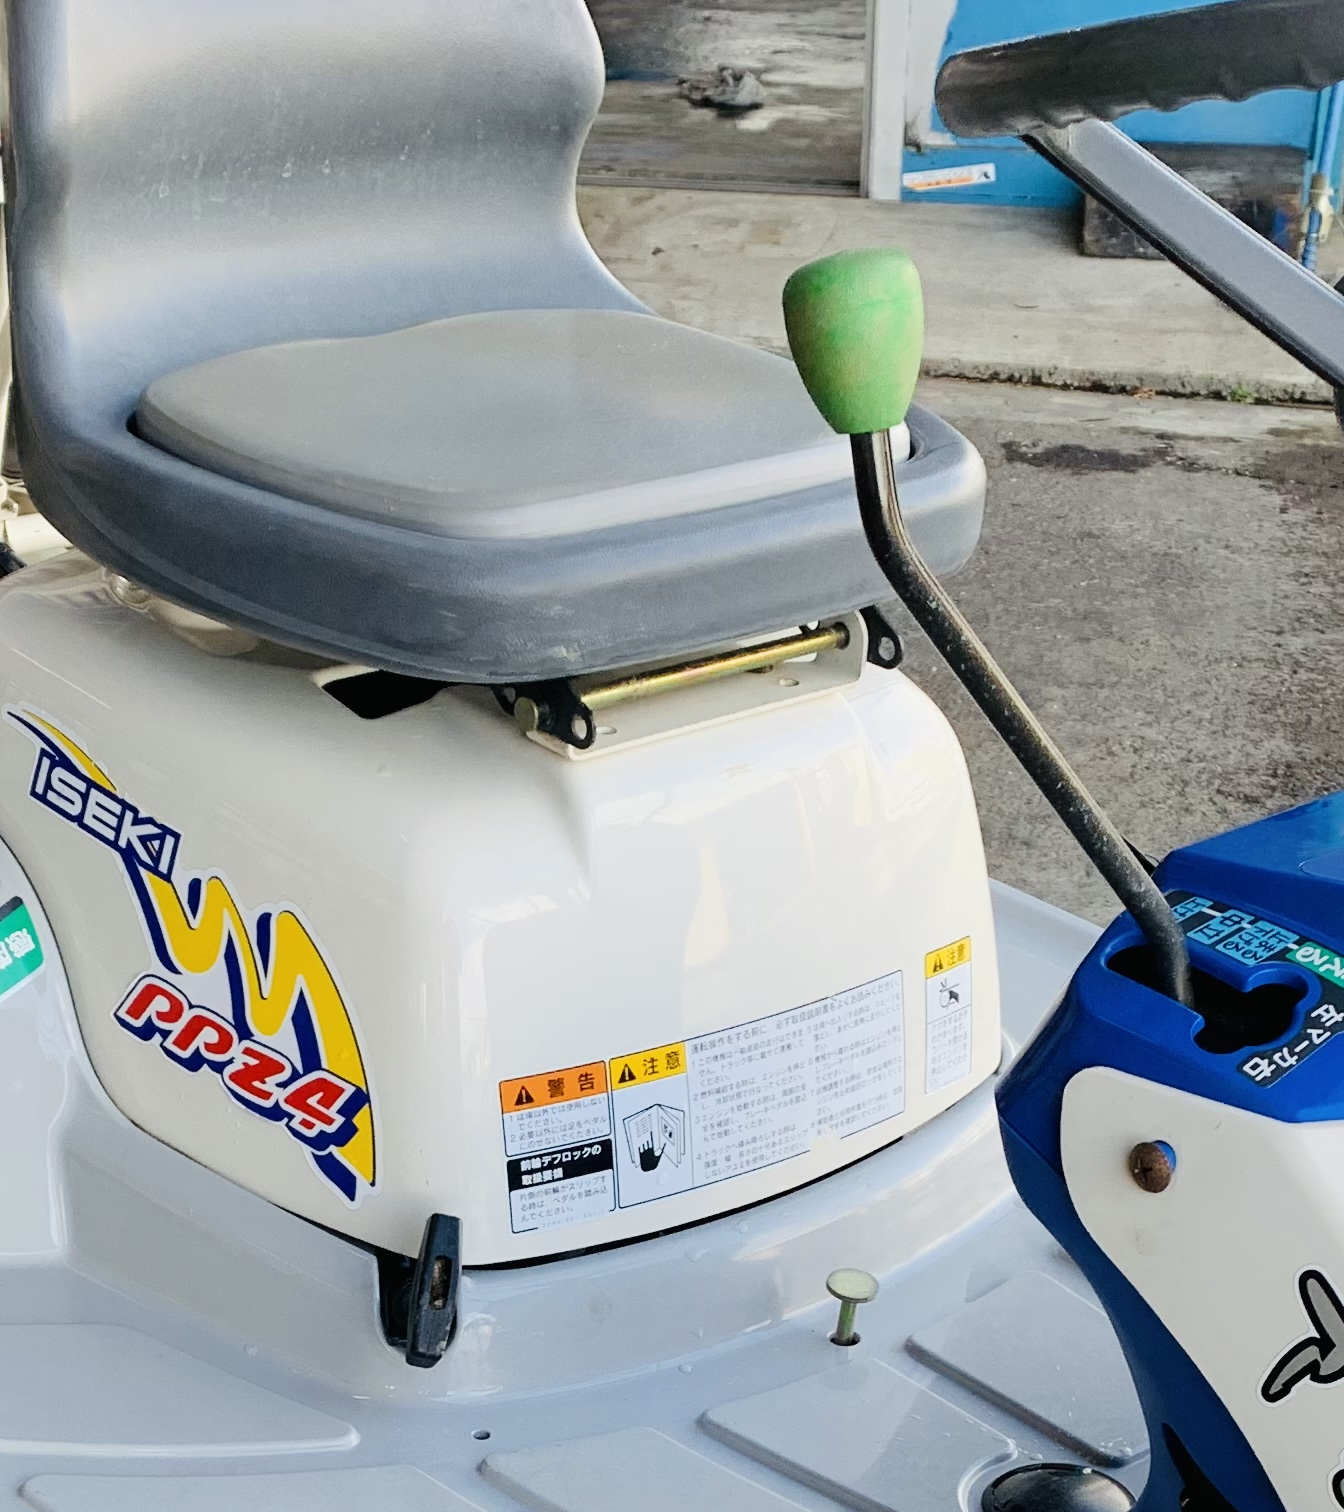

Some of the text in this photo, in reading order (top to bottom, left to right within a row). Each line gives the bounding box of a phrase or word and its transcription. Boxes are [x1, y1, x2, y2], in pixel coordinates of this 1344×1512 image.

[33, 754, 178, 877] ISEKI
[1172, 897, 1207, 921] 上げ
[642, 1050, 681, 1077] 注意
[547, 1071, 595, 1098] 警告
